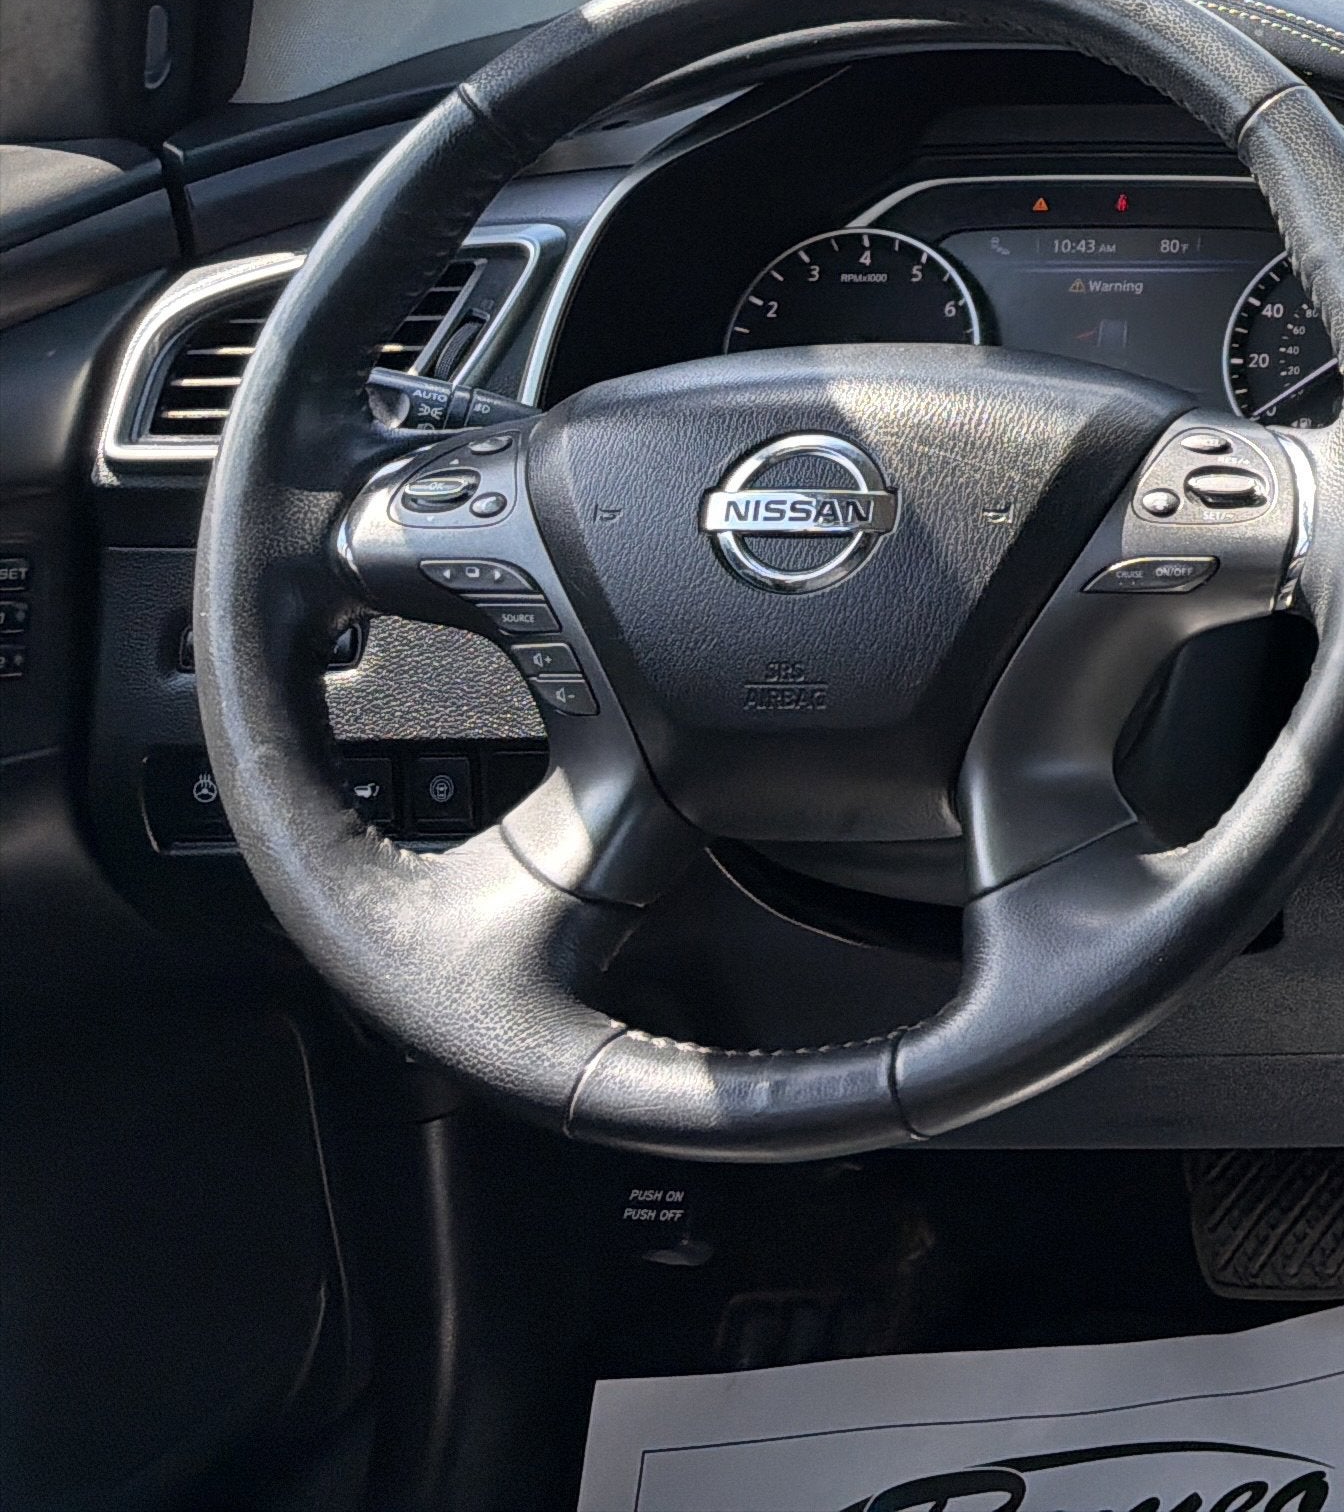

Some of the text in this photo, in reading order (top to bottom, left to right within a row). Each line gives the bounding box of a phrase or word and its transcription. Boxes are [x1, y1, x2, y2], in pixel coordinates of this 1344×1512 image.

[1053, 239, 1097, 253] 10:43
[1099, 243, 1116, 253] AM
[860, 250, 871, 266] 4
[808, 265, 820, 282] 3
[911, 265, 923, 282] 5
[1089, 279, 1144, 295] Warning
[767, 301, 778, 318] 2
[944, 301, 956, 318] 6
[1262, 303, 1284, 319] 40
[1292, 325, 1306, 336] 60
[1286, 345, 1300, 356] 40
[1249, 353, 1270, 368] 20
[1288, 365, 1300, 376] 20
[412, 389, 448, 403] AUTO
[724, 499, 874, 524] NISSAN
[1115, 566, 1193, 579] CRUISE ON/OFF
[501, 613, 535, 623] SOURCE
[628, 1189, 685, 1202] PUSH ON
[623, 1207, 685, 1221] PUSH OFF
